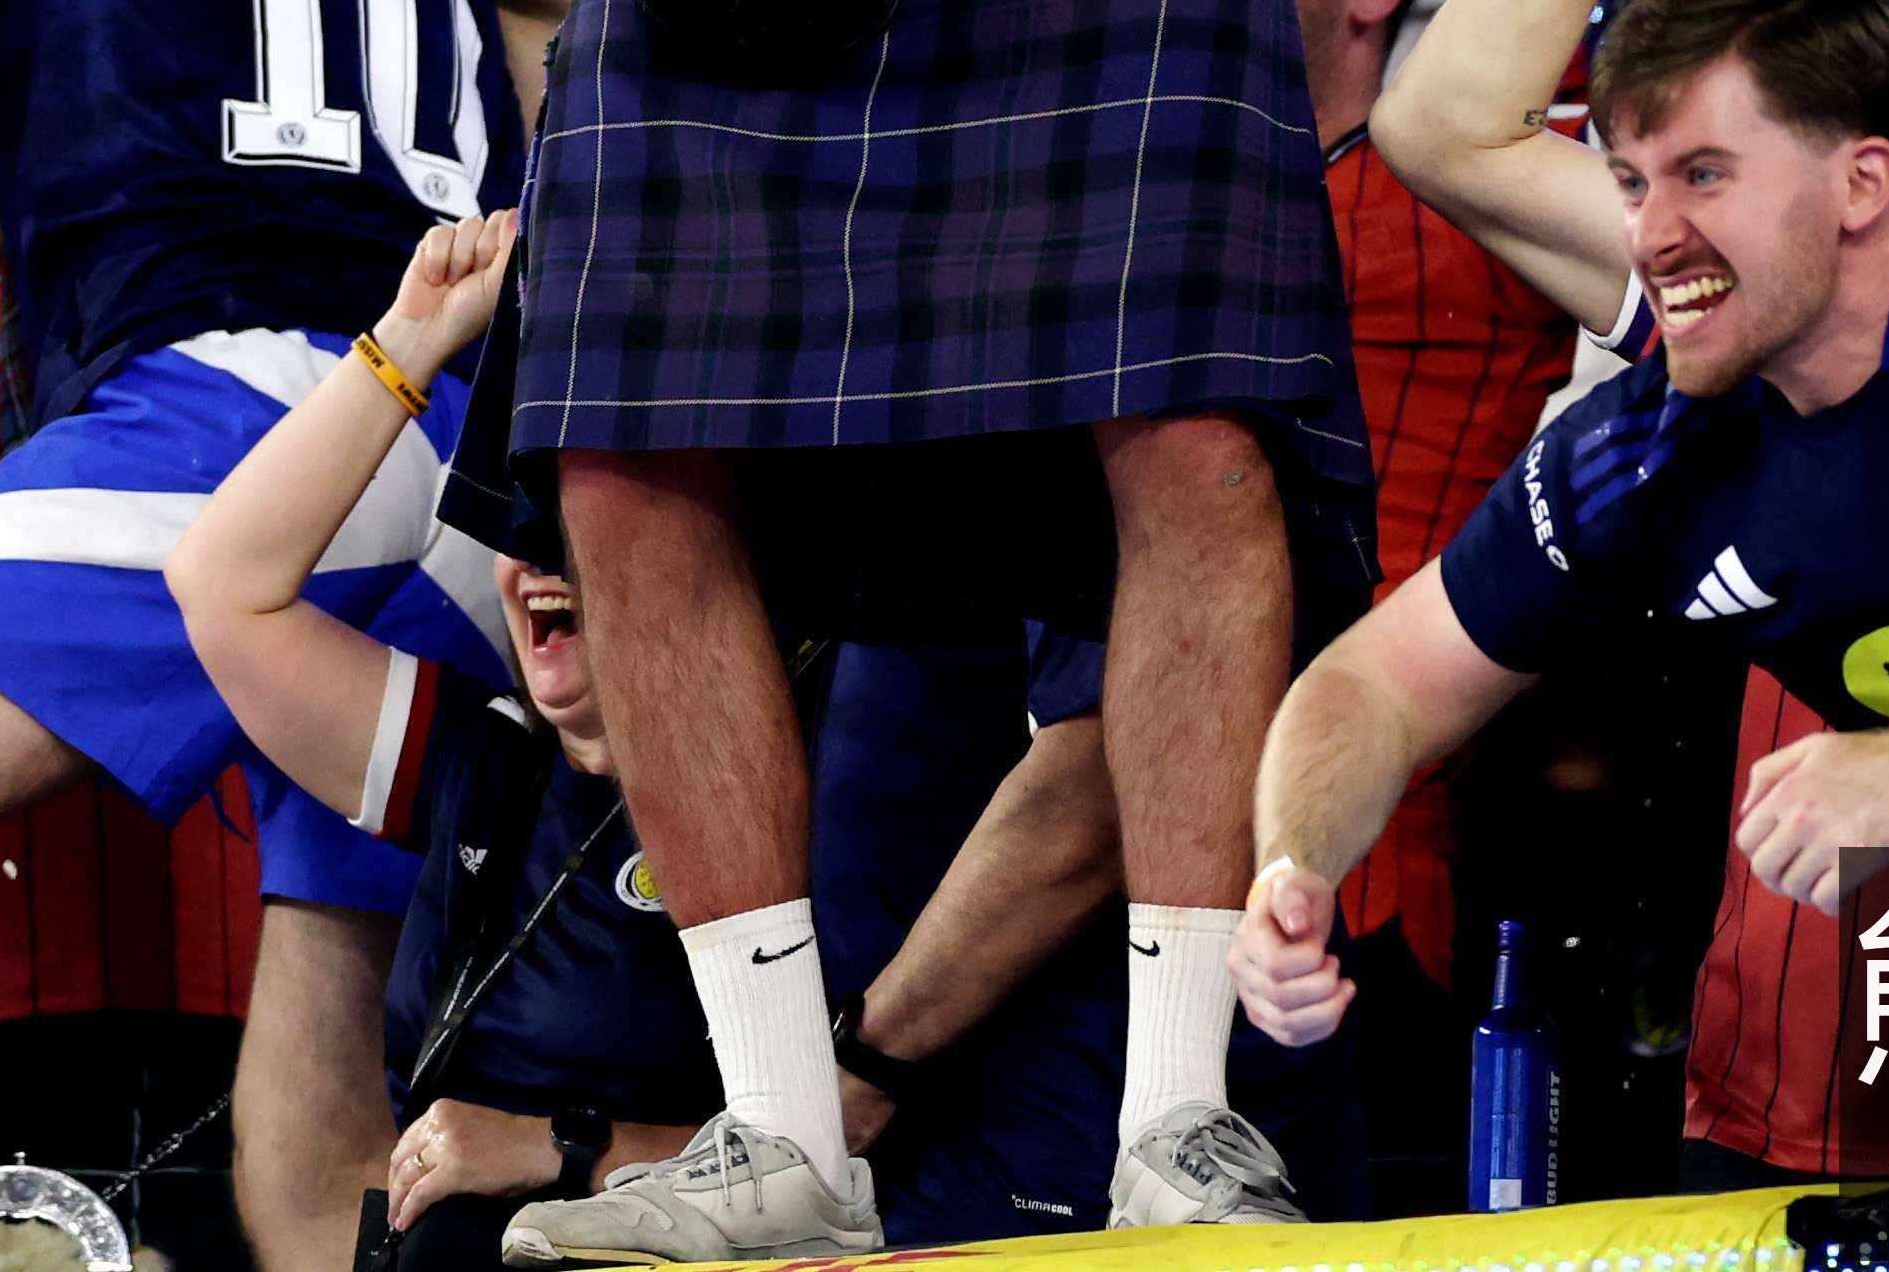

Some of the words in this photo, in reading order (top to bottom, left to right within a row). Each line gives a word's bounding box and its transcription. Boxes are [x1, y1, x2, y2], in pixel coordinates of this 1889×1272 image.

[1524, 439, 1554, 547] CHASE
[1548, 1071, 1561, 1149] LIGHT
[1013, 1195, 1074, 1217] CLIMACOOL
[1546, 1151, 1559, 1206] BUD
